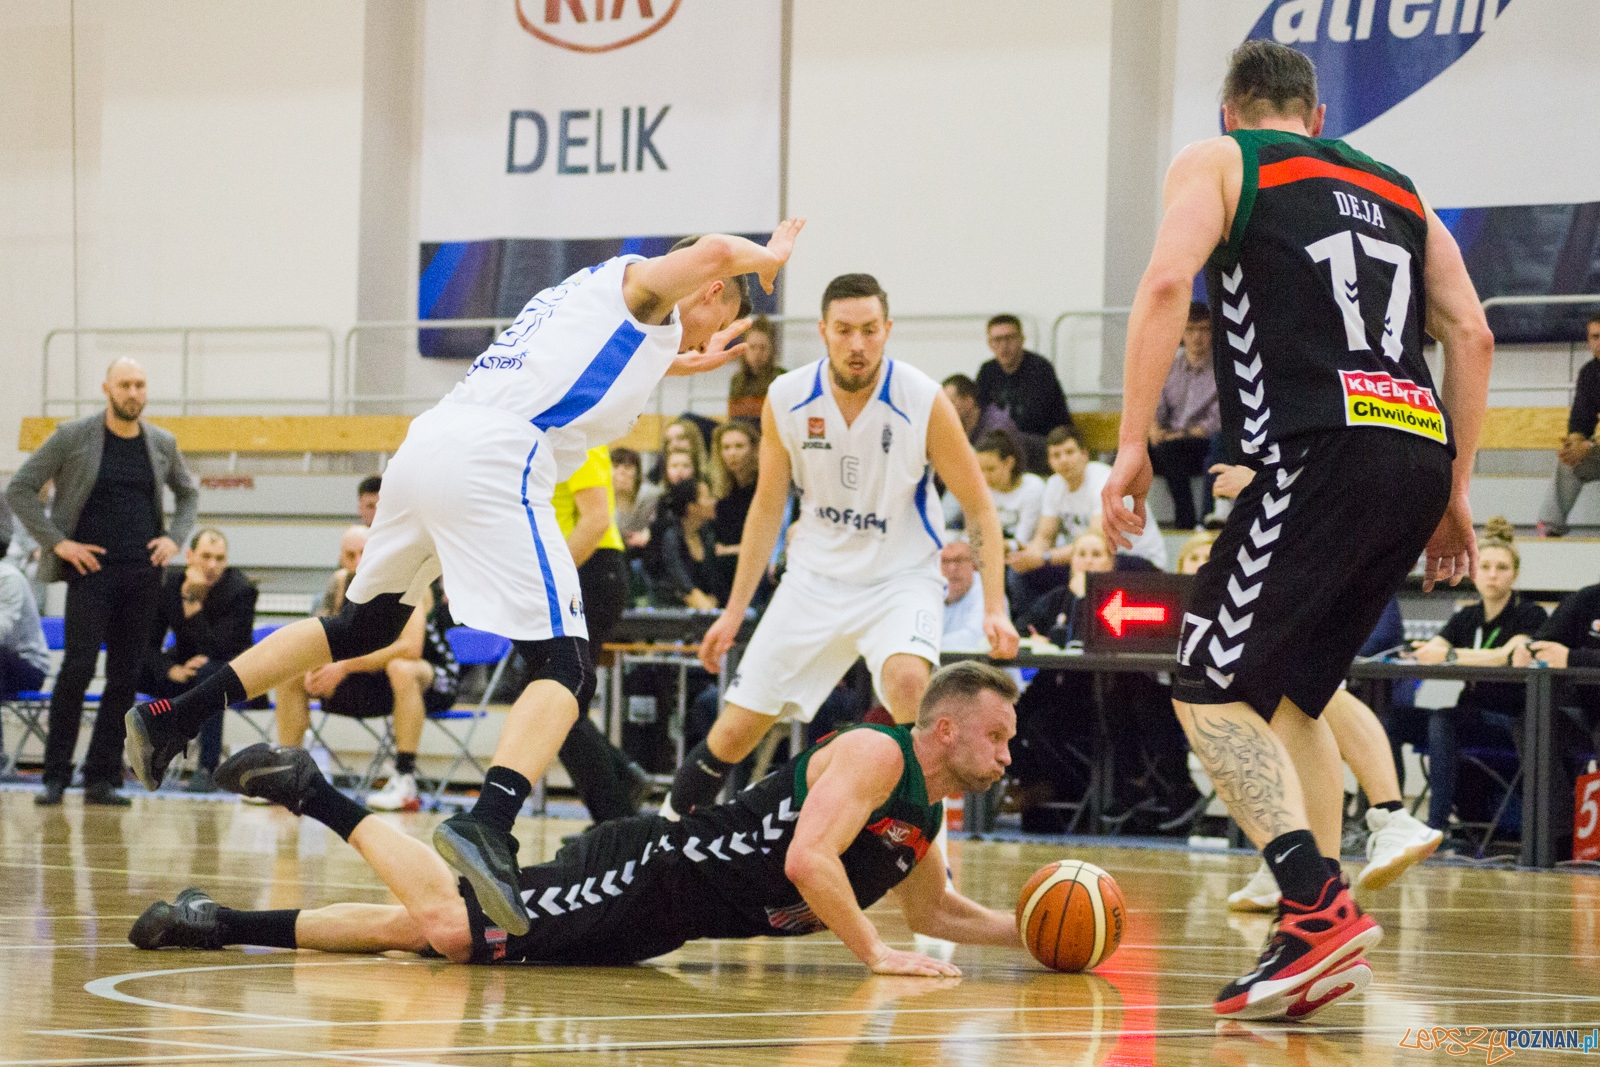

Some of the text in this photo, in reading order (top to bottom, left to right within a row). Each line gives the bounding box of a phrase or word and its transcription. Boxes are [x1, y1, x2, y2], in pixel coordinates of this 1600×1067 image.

[506, 104, 672, 175] DELIK
[1333, 190, 1386, 229] DEJA
[1304, 229, 1412, 363] 17
[1353, 400, 1443, 434] Chwilówki
[1577, 779, 1600, 839] 5
